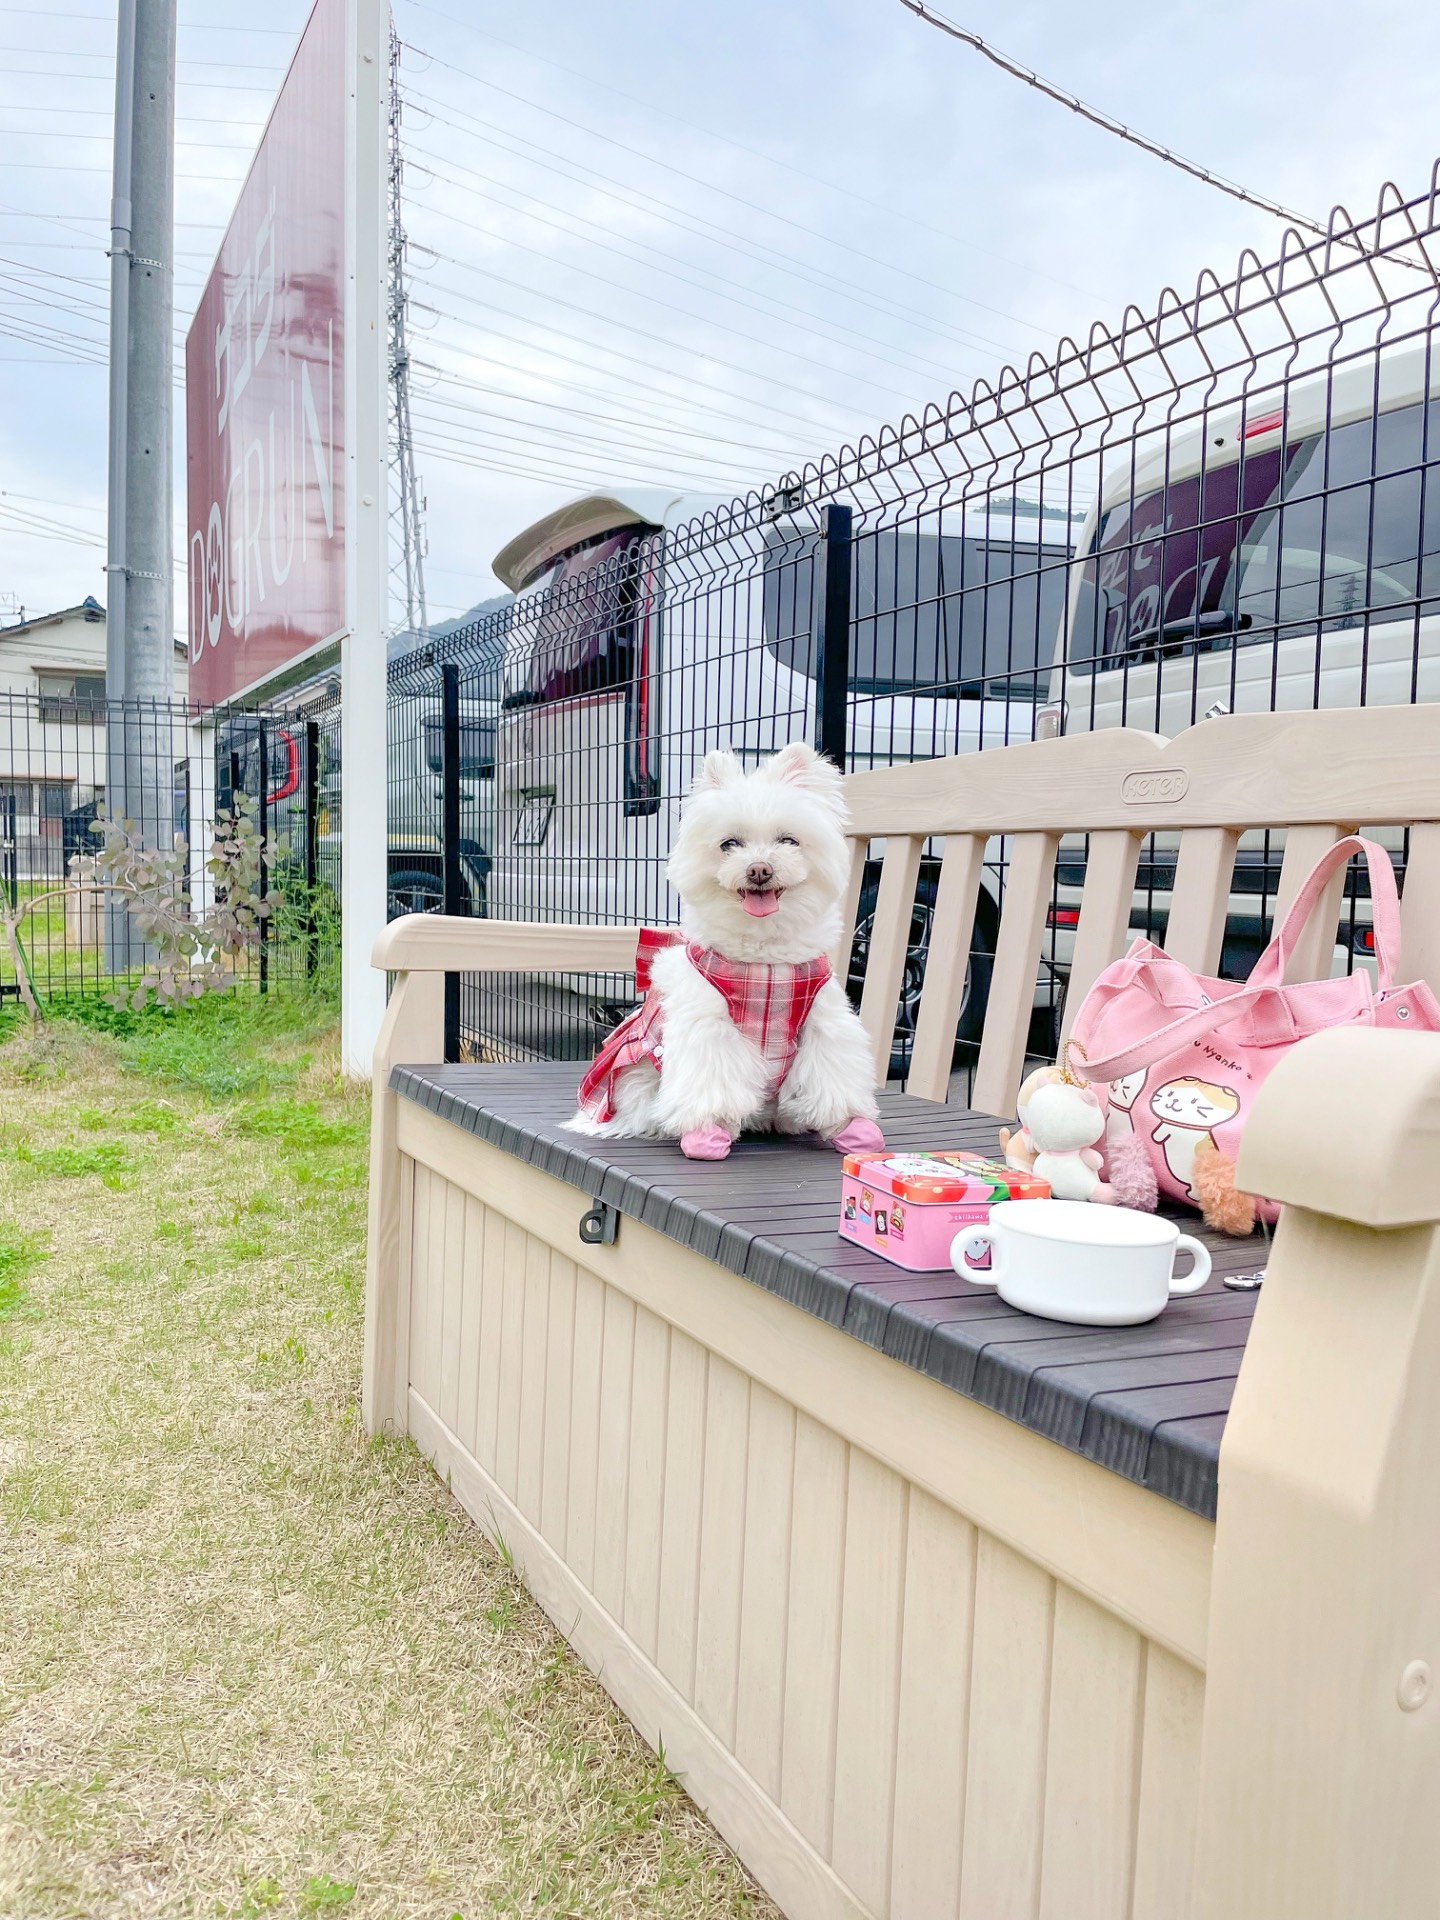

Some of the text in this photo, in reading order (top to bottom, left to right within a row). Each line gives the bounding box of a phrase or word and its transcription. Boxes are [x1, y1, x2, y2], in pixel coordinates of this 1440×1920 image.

[215, 184, 277, 436] サコダ
[1202, 1045, 1242, 1071] Nyanko
